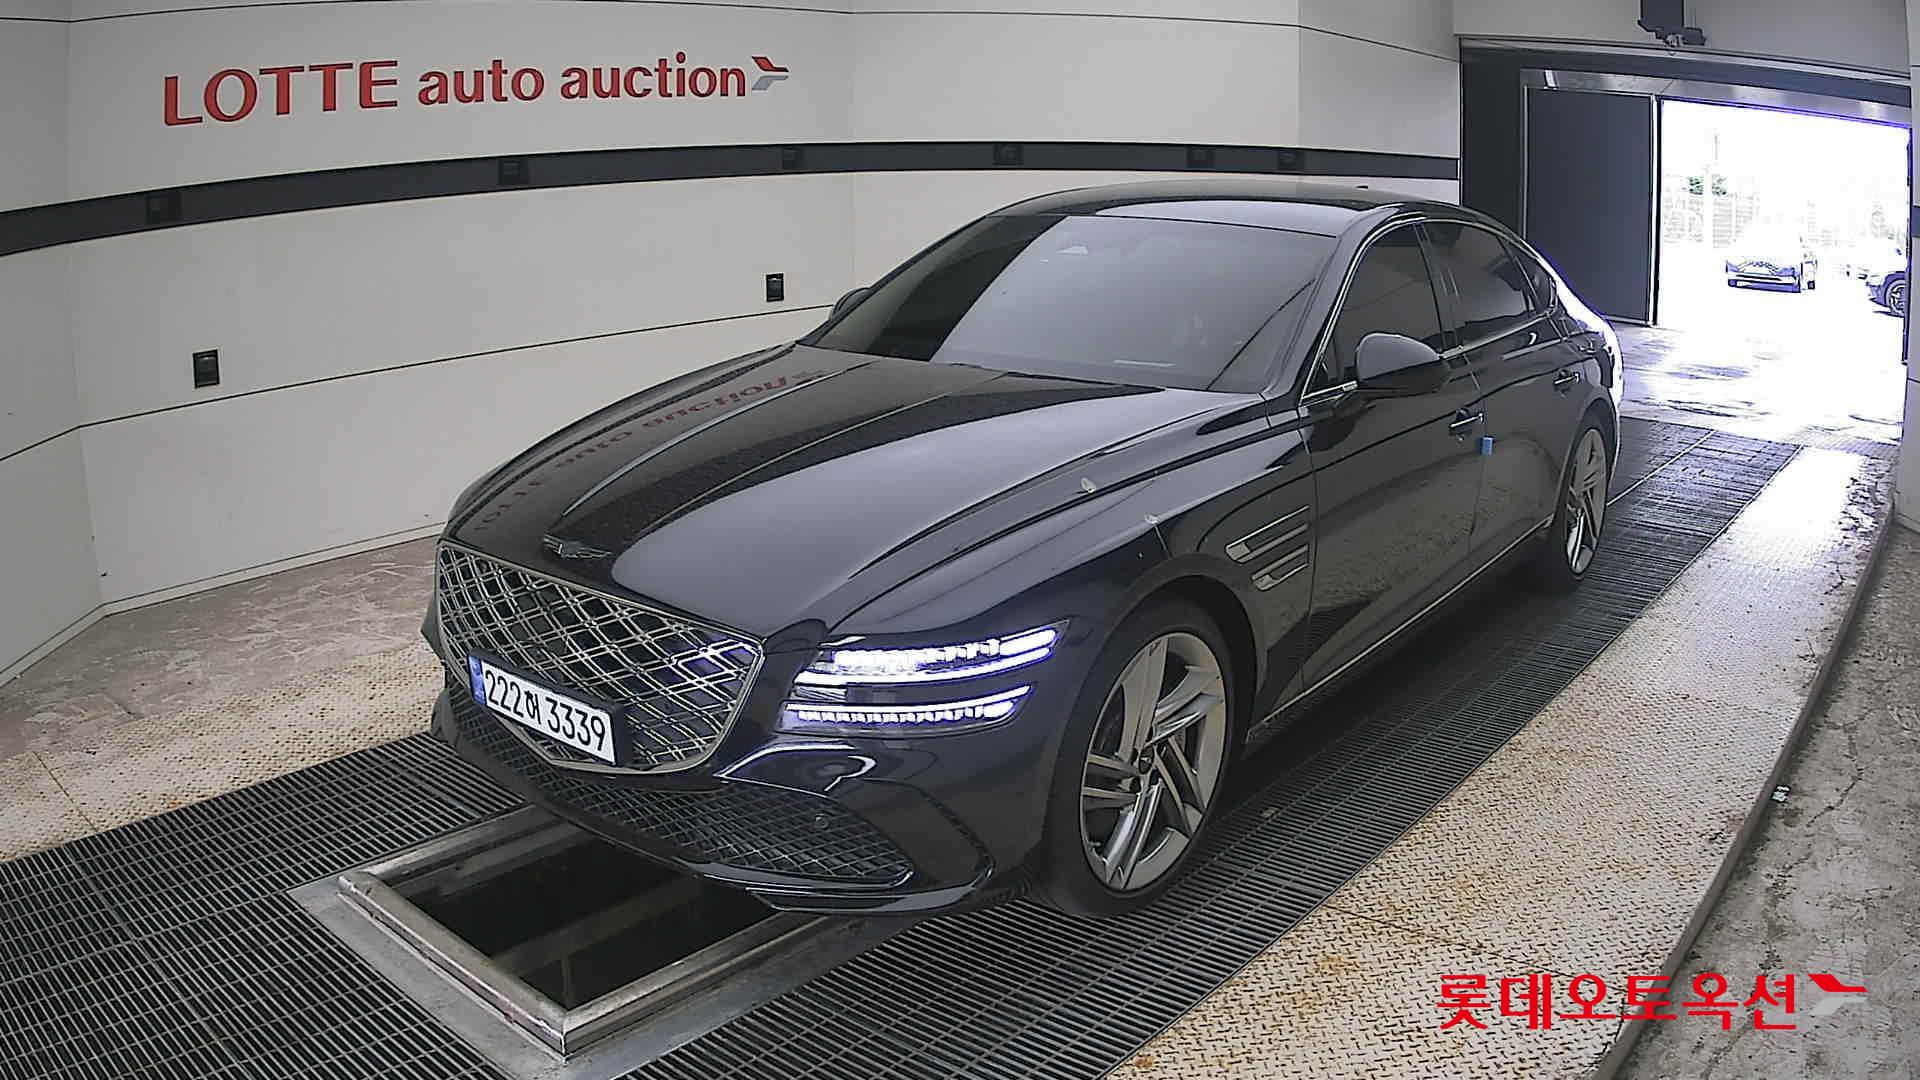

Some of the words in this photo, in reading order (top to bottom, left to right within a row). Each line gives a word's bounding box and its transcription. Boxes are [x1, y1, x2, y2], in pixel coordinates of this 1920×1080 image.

[163, 60, 398, 126] LOTTE
[418, 58, 546, 105] auto
[560, 52, 747, 97] auction
[545, 696, 606, 751] 3339
